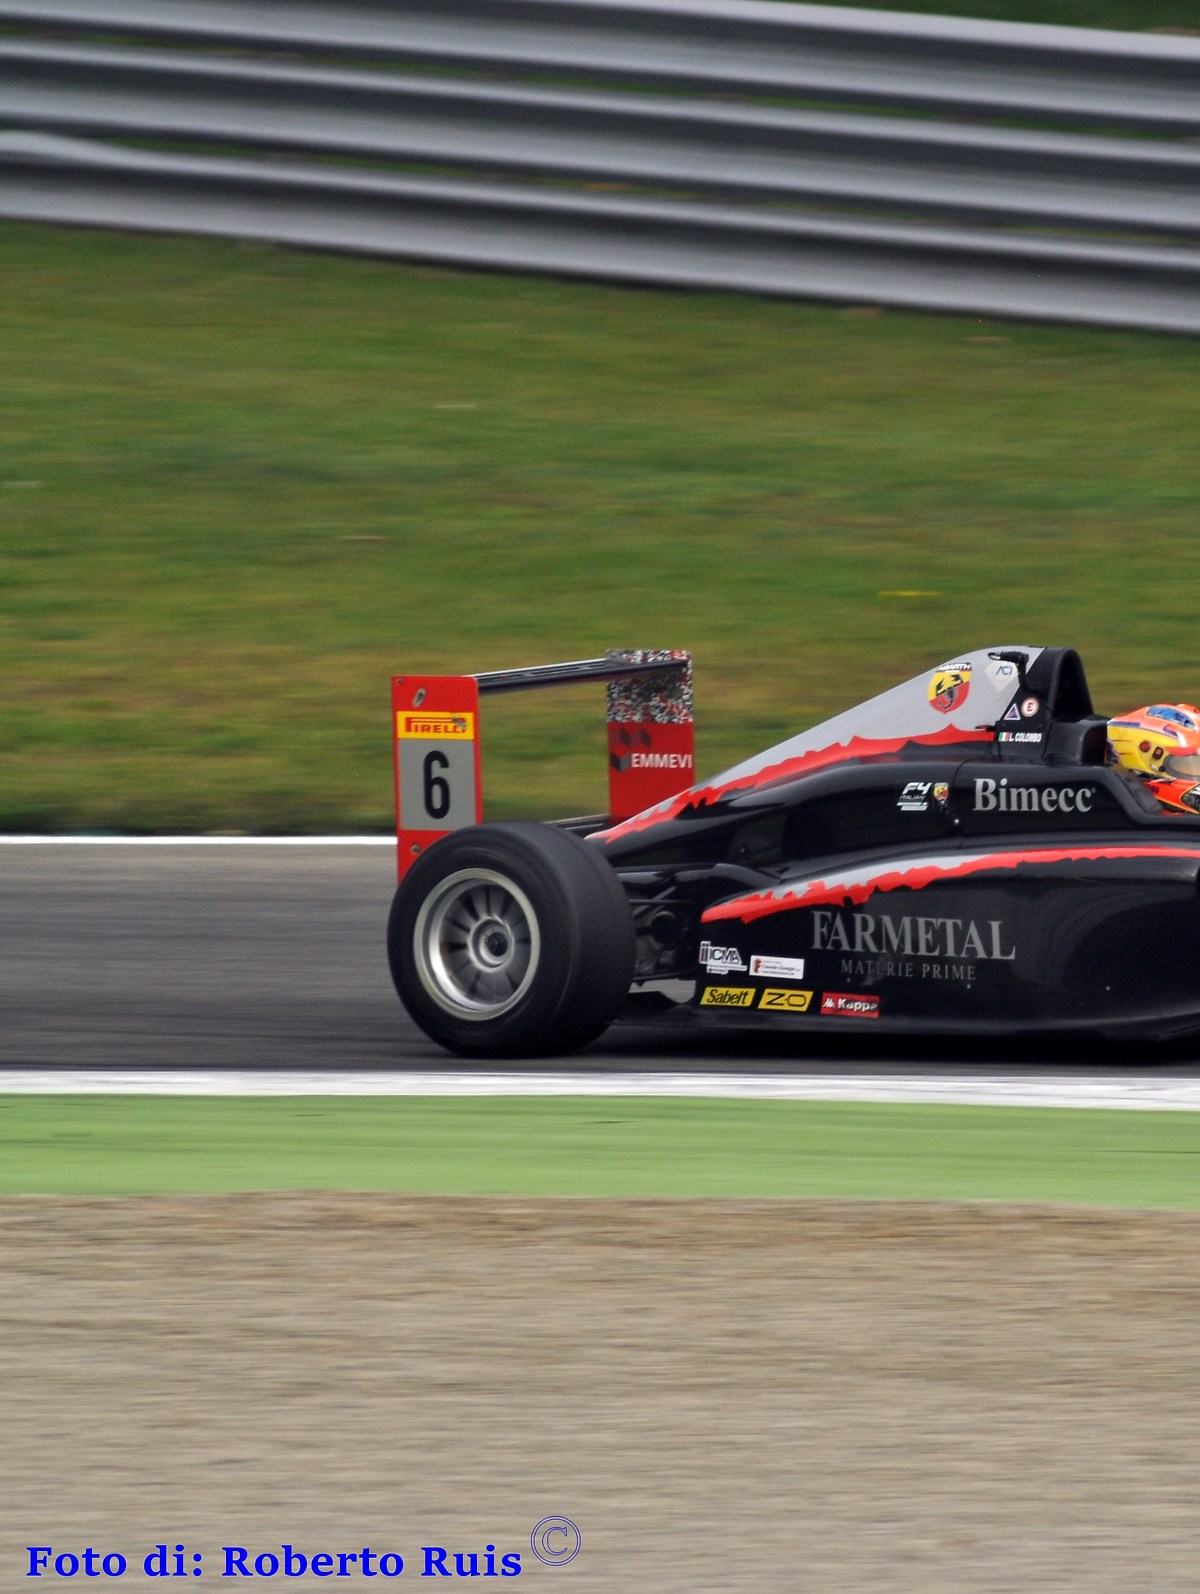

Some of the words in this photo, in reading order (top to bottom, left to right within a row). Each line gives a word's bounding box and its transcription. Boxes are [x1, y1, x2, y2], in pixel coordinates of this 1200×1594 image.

[996, 666, 1012, 675] ACI
[1015, 733, 1042, 743] COLOMBO
[631, 753, 692, 768] EMMEVI
[423, 751, 449, 819] 6
[902, 782, 932, 795] F4
[973, 778, 1092, 812] Bimecc
[811, 910, 1016, 960] FARMETAL
[921, 962, 976, 981] PRIME
[707, 989, 749, 1004] Sabelt
[837, 999, 878, 1011] Kappa
